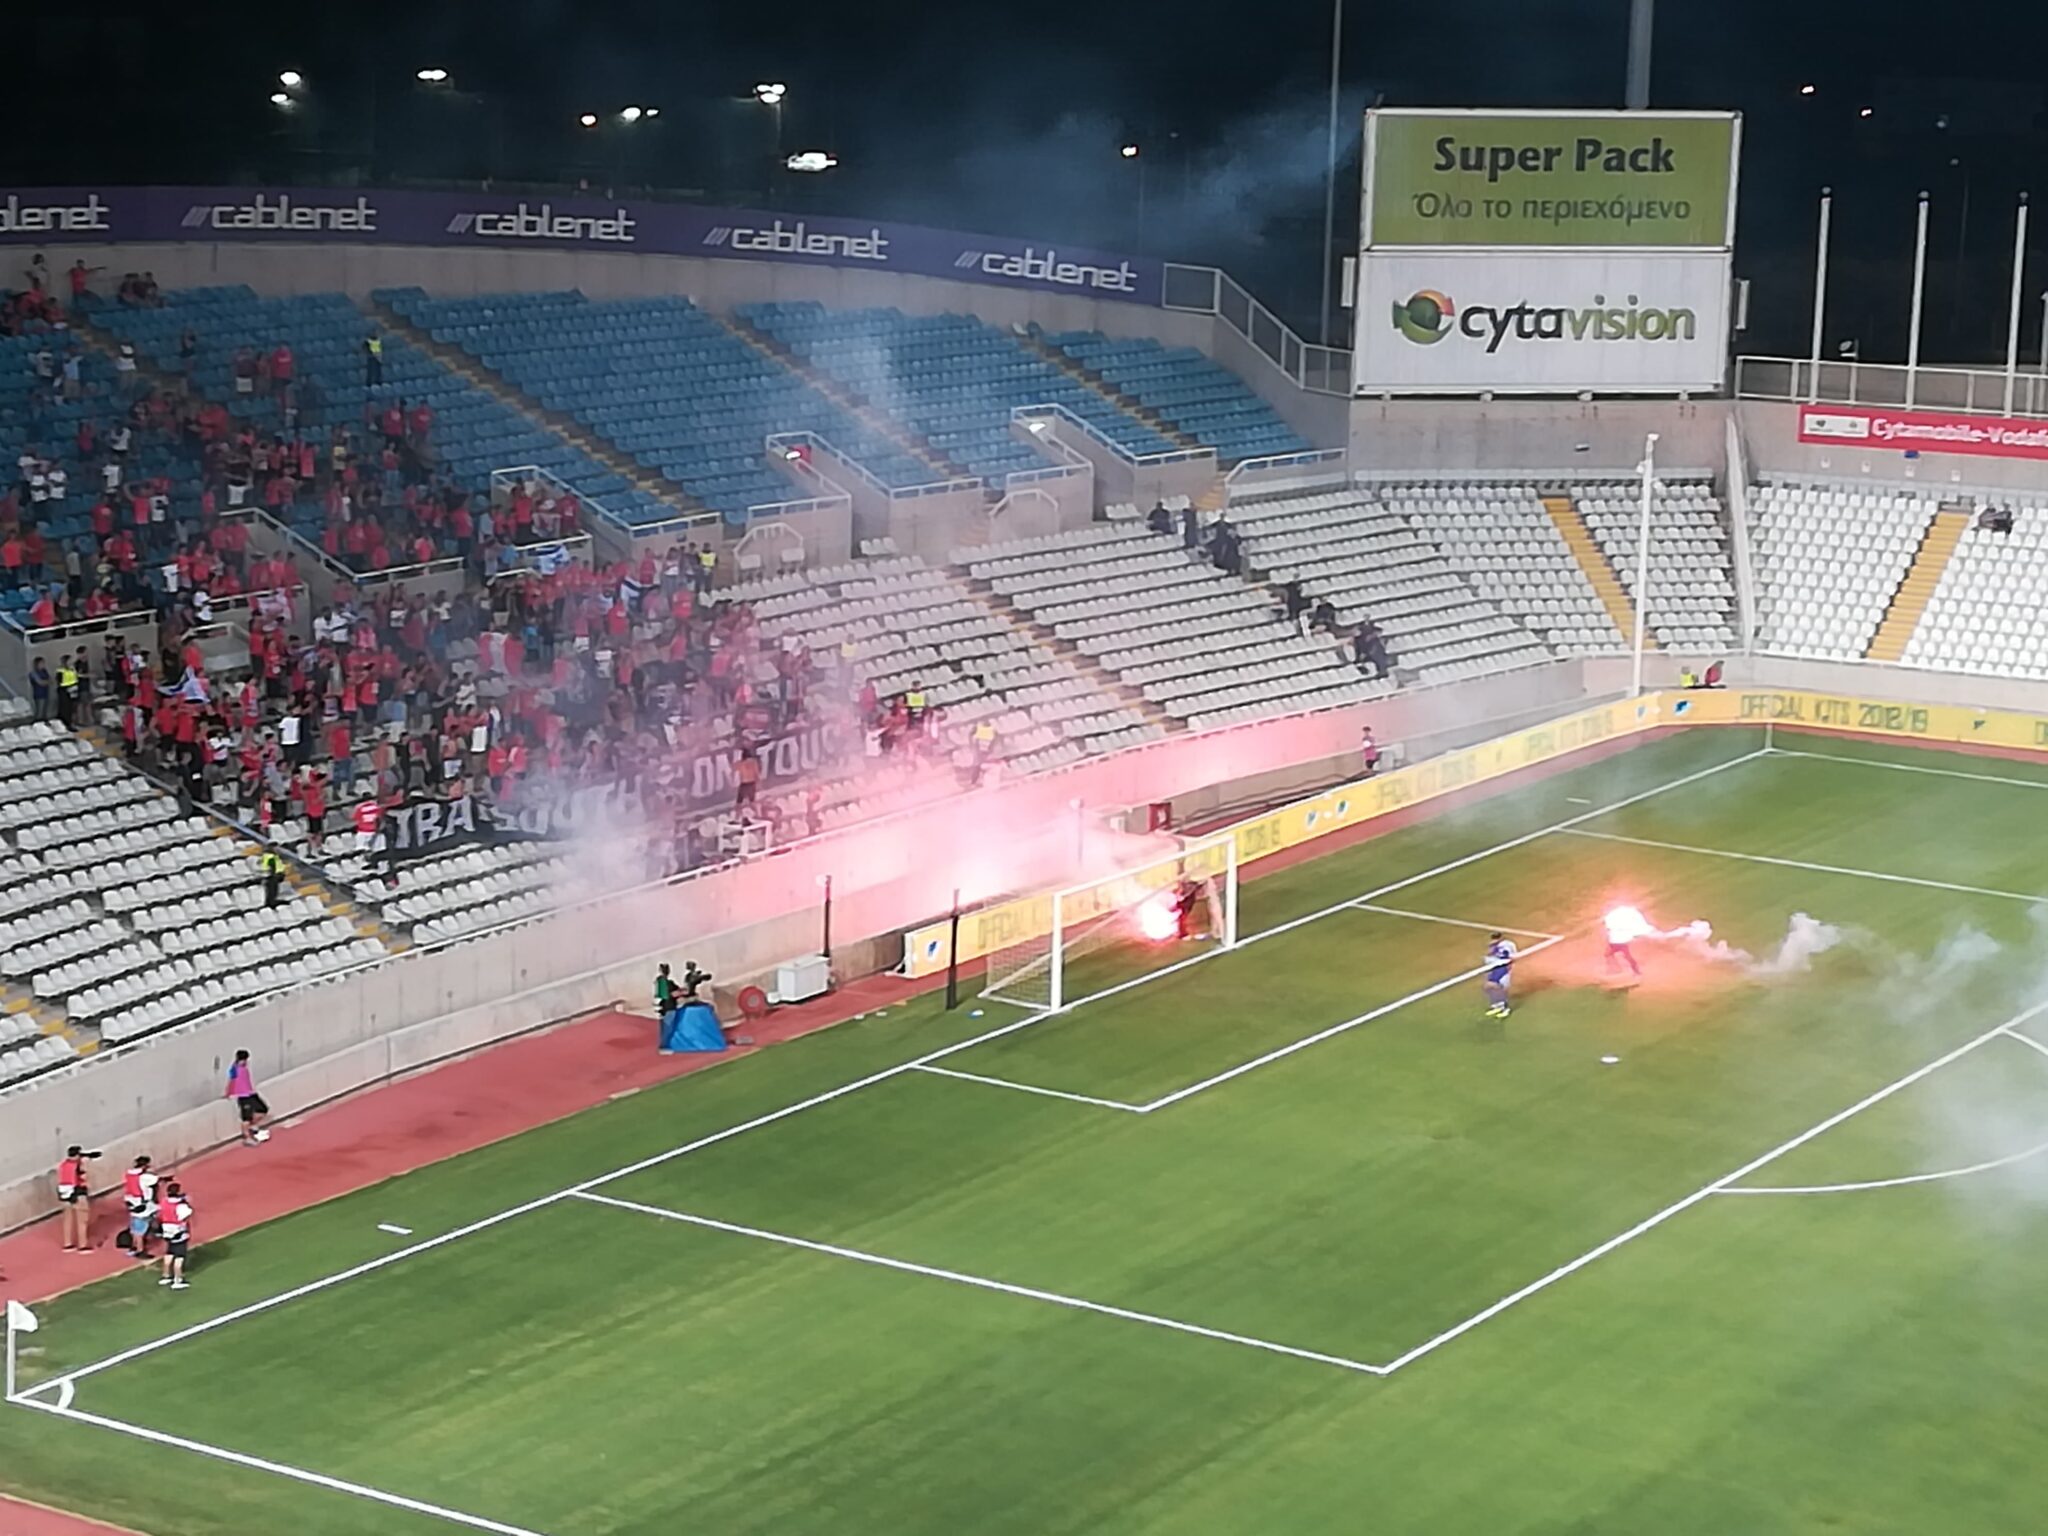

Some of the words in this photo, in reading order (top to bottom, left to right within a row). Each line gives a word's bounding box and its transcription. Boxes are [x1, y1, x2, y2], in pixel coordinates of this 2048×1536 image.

[1433, 136, 1563, 183] Super
[1574, 137, 1676, 173] Pack
[211, 194, 376, 230] cablenet
[475, 203, 636, 241] cablenet
[1482, 199, 1511, 219] το
[1522, 194, 1691, 227] περιεχόμενο
[731, 220, 890, 260] cablenet
[982, 247, 1138, 292] cablenet
[1460, 294, 1696, 353] cytavision
[691, 750, 741, 798] ON
